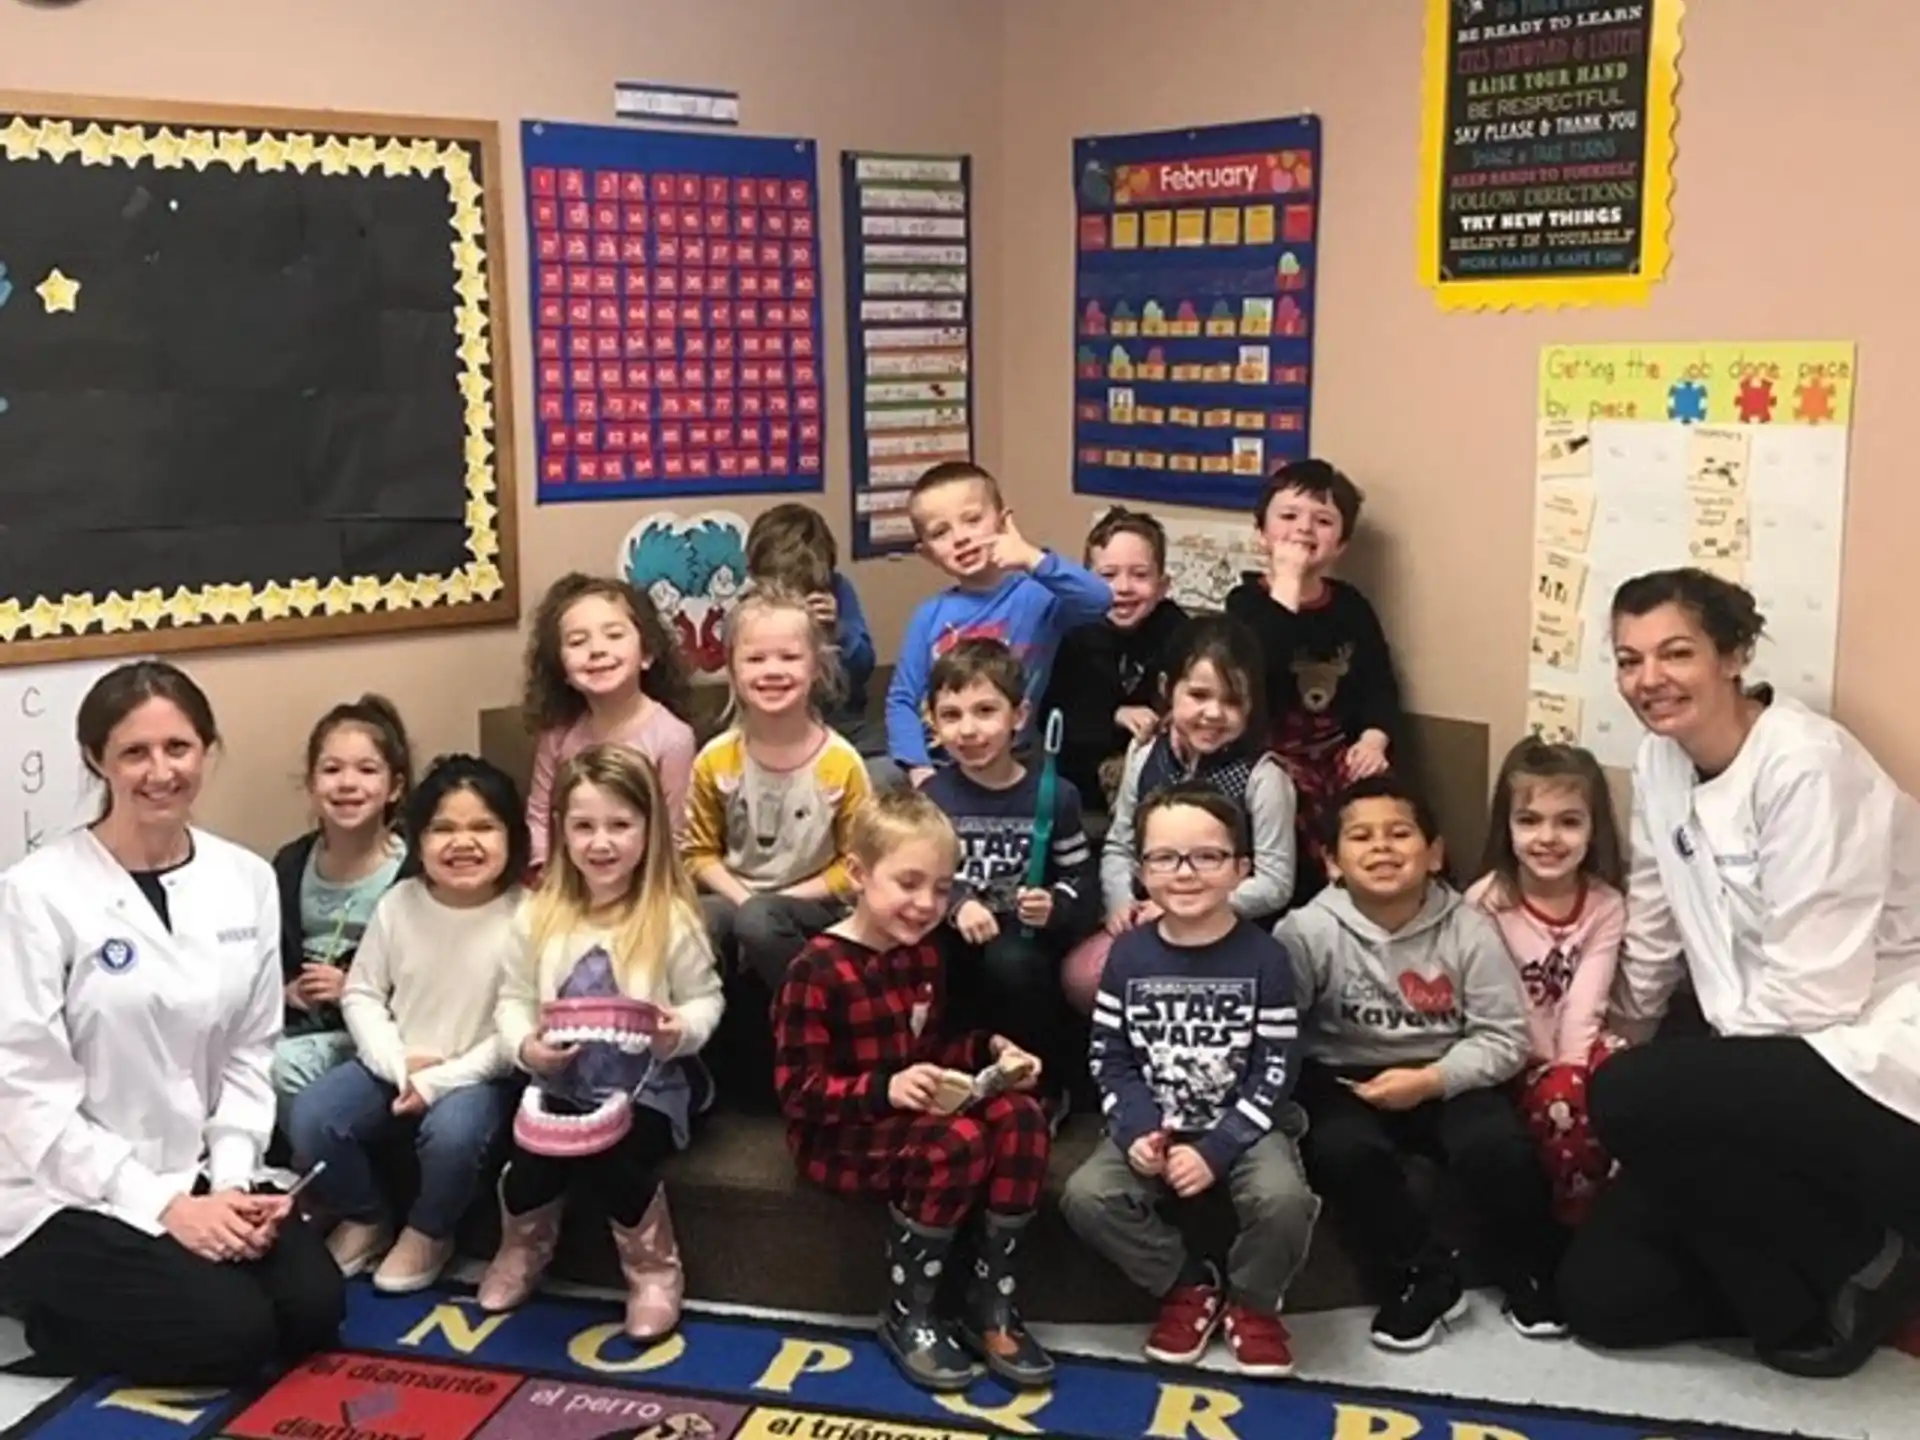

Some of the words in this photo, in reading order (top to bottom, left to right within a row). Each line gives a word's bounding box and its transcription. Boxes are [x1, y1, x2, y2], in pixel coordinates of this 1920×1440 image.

[1484, 19, 1544, 39] READY
[1550, 16, 1572, 31] TO
[1577, 6, 1644, 27] LEARN
[1467, 75, 1516, 96] RAISE
[1523, 68, 1571, 91] YOUR
[1576, 62, 1628, 85] HAND
[1467, 102, 1493, 120] BE
[1497, 88, 1626, 117] RESPECTFUL
[1454, 126, 1481, 146] SAY
[1484, 120, 1535, 142] PLEASE
[1556, 114, 1602, 134] THANK
[1608, 110, 1637, 131] YOU
[1160, 162, 1259, 193] February
[1523, 180, 1637, 207] DIRECTIONS
[1460, 214, 1497, 232] TRY
[1501, 211, 1544, 229] NEW
[1548, 206, 1622, 227] THINGS
[1546, 348, 1615, 384] Getting
[1624, 348, 1661, 379] the
[1729, 350, 1780, 380] done
[1798, 360, 1850, 383] piece
[1546, 387, 1570, 418] by
[1588, 399, 1637, 422] piece
[21, 750, 45, 794] g
[1132, 992, 1248, 1021] STAR
[1130, 1025, 1251, 1048] WARS
[348, 1363, 499, 1395] diamante
[396, 1303, 511, 1354] N
[566, 1323, 687, 1373] O
[748, 1338, 854, 1392] P
[1145, 1383, 1243, 1440] R
[529, 1386, 566, 1406] el
[563, 1393, 663, 1420] perro
[767, 1415, 803, 1437] el
[810, 1417, 952, 1440] trián
